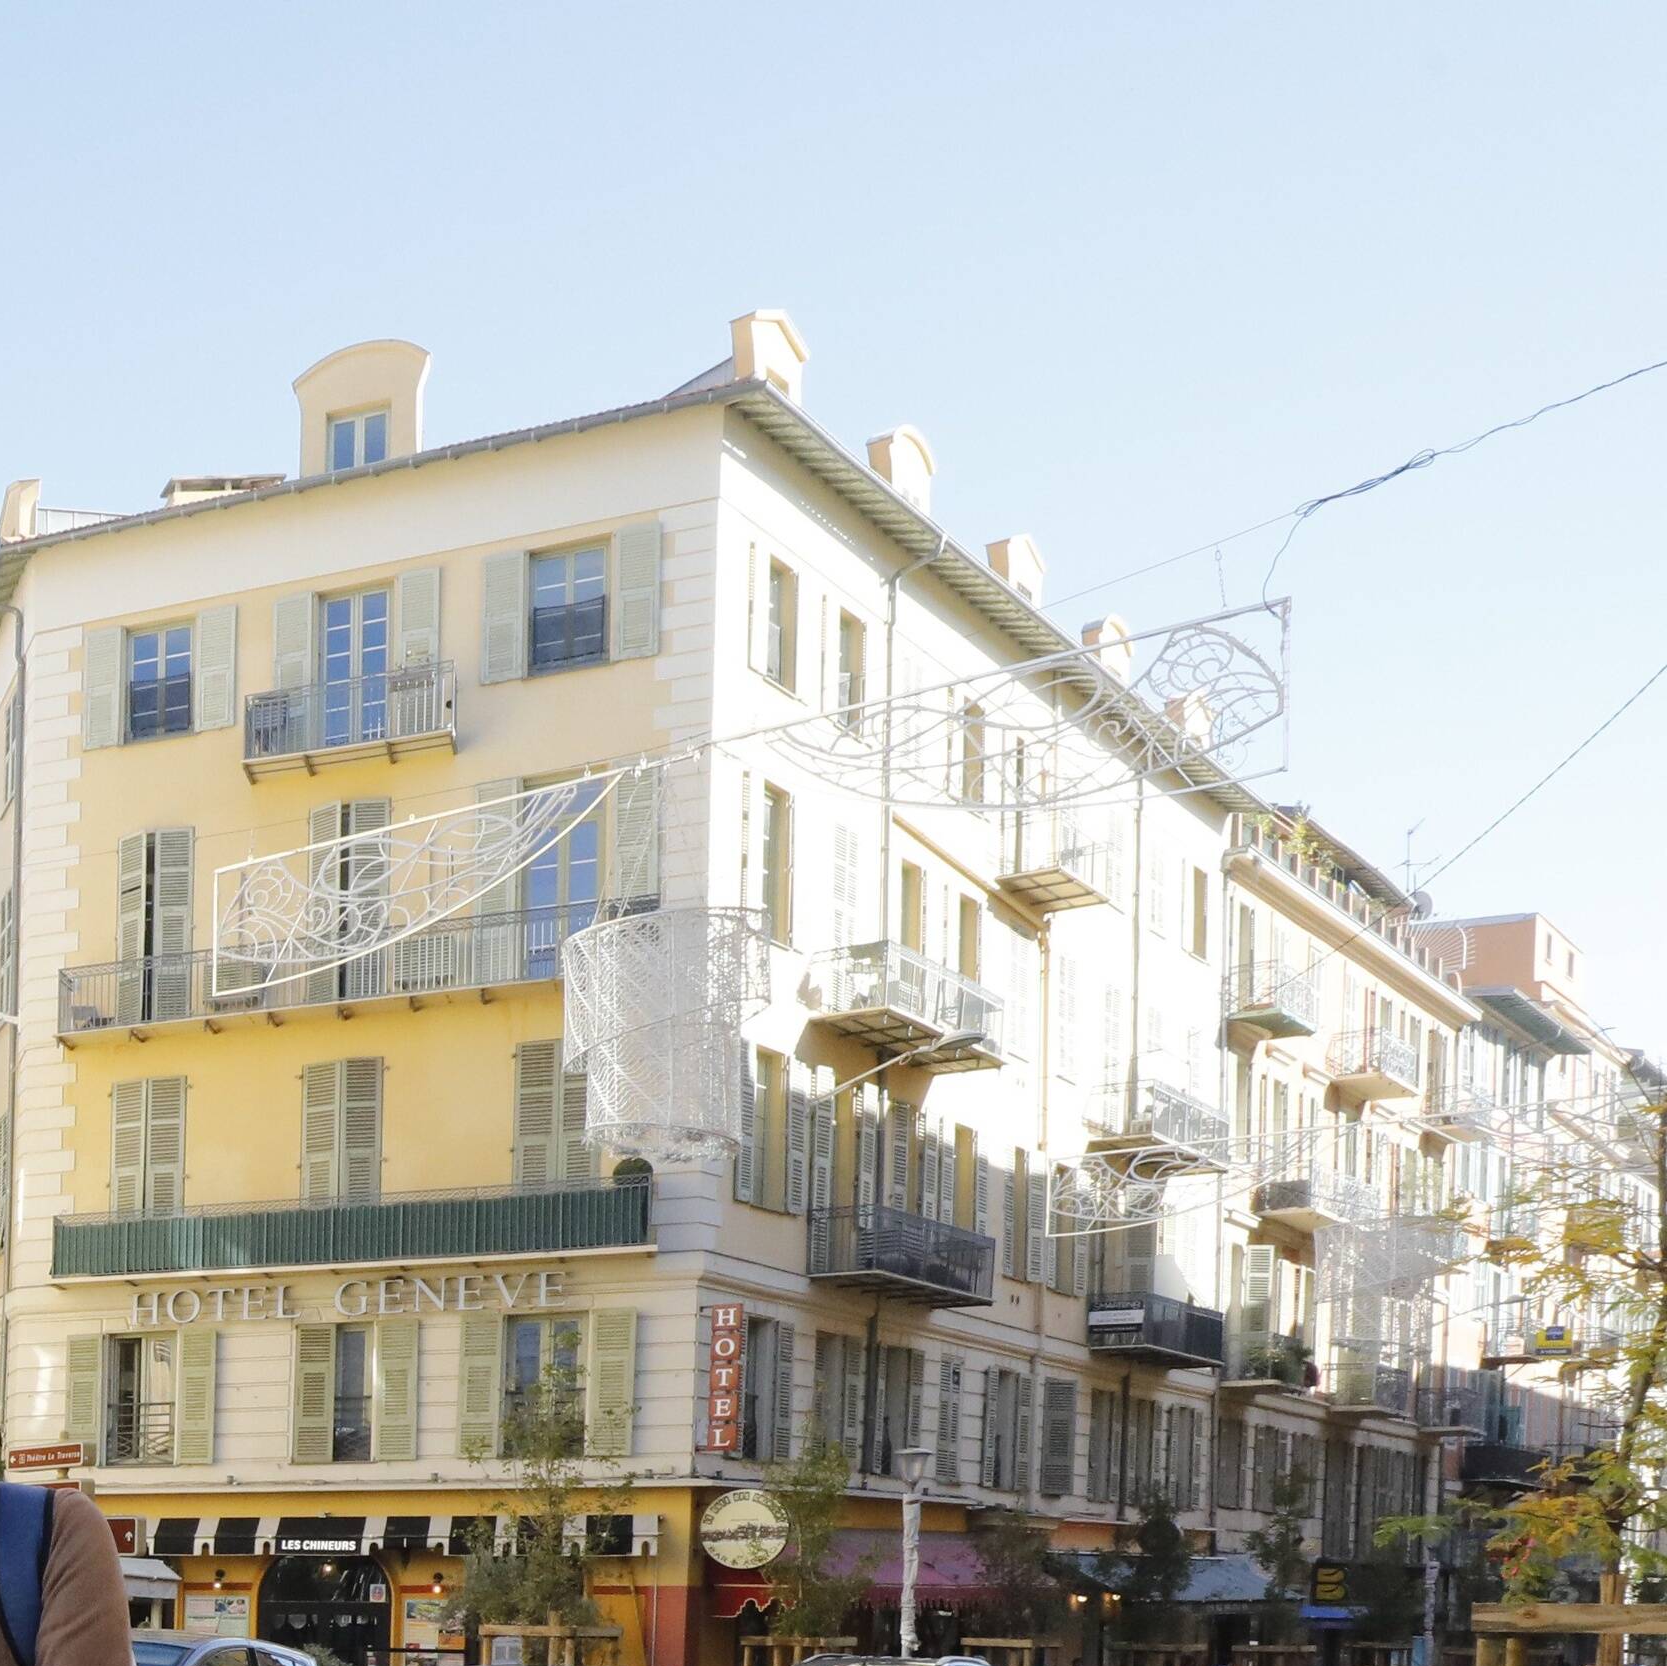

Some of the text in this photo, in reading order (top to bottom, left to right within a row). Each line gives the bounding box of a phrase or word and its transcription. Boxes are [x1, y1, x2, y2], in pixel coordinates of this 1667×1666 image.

[130, 1271, 567, 1326] HOTEL GENEVE
[712, 1307, 737, 1447] HOTEL
[281, 1540, 357, 1551] LES CHINEURS
